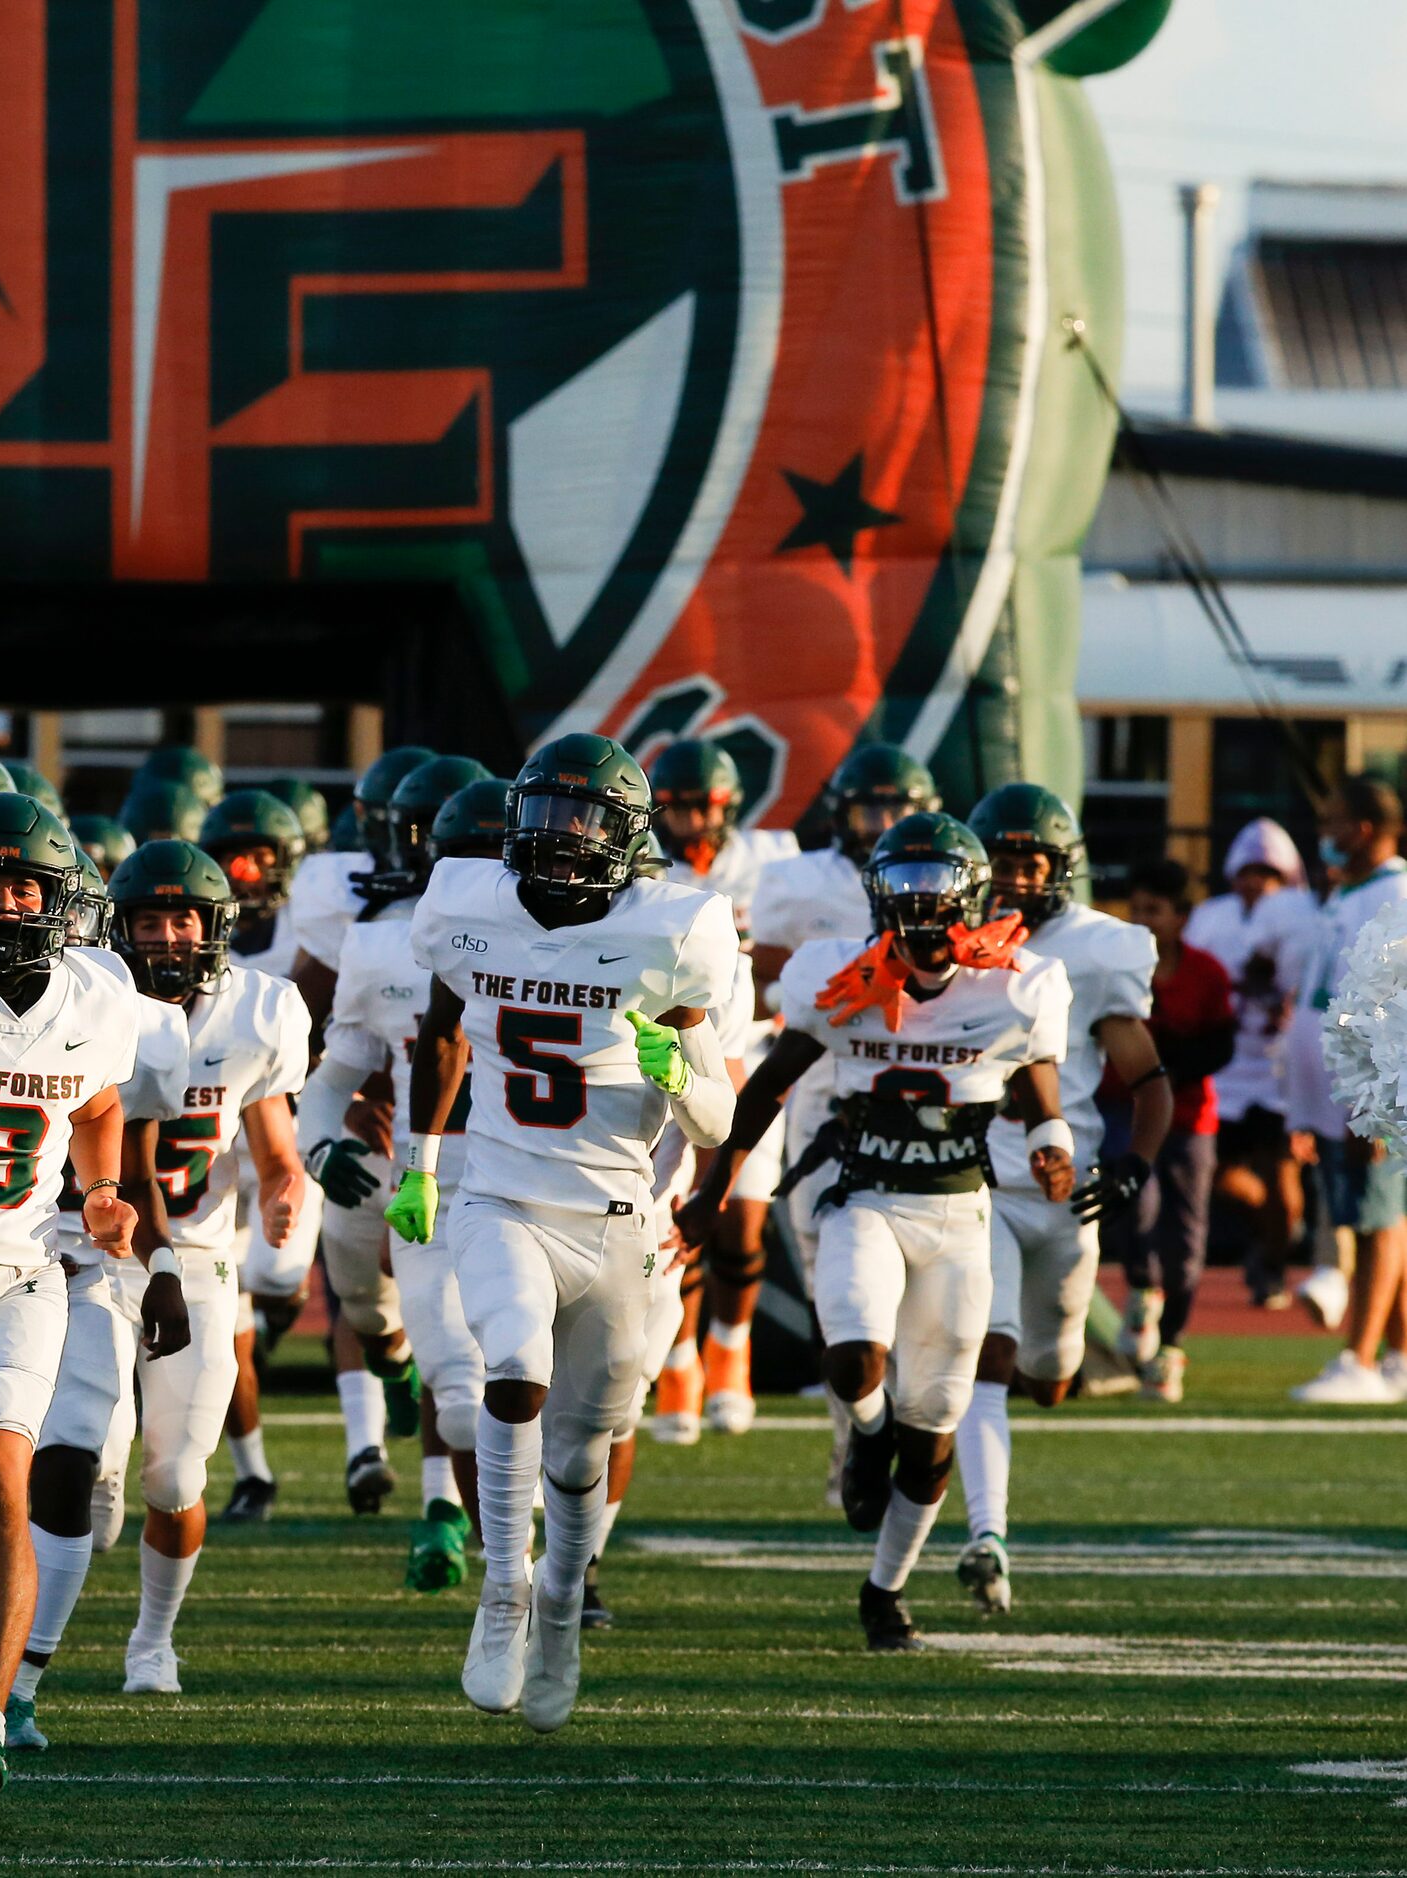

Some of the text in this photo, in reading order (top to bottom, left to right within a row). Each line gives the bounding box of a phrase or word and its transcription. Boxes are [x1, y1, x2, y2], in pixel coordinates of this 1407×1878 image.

[472, 971, 622, 1009] THE FOREST
[496, 1004, 587, 1130] 5
[849, 1039, 983, 1064] THE FOREST
[857, 1130, 977, 1164] WAM
[616, 1203, 627, 1213] M
